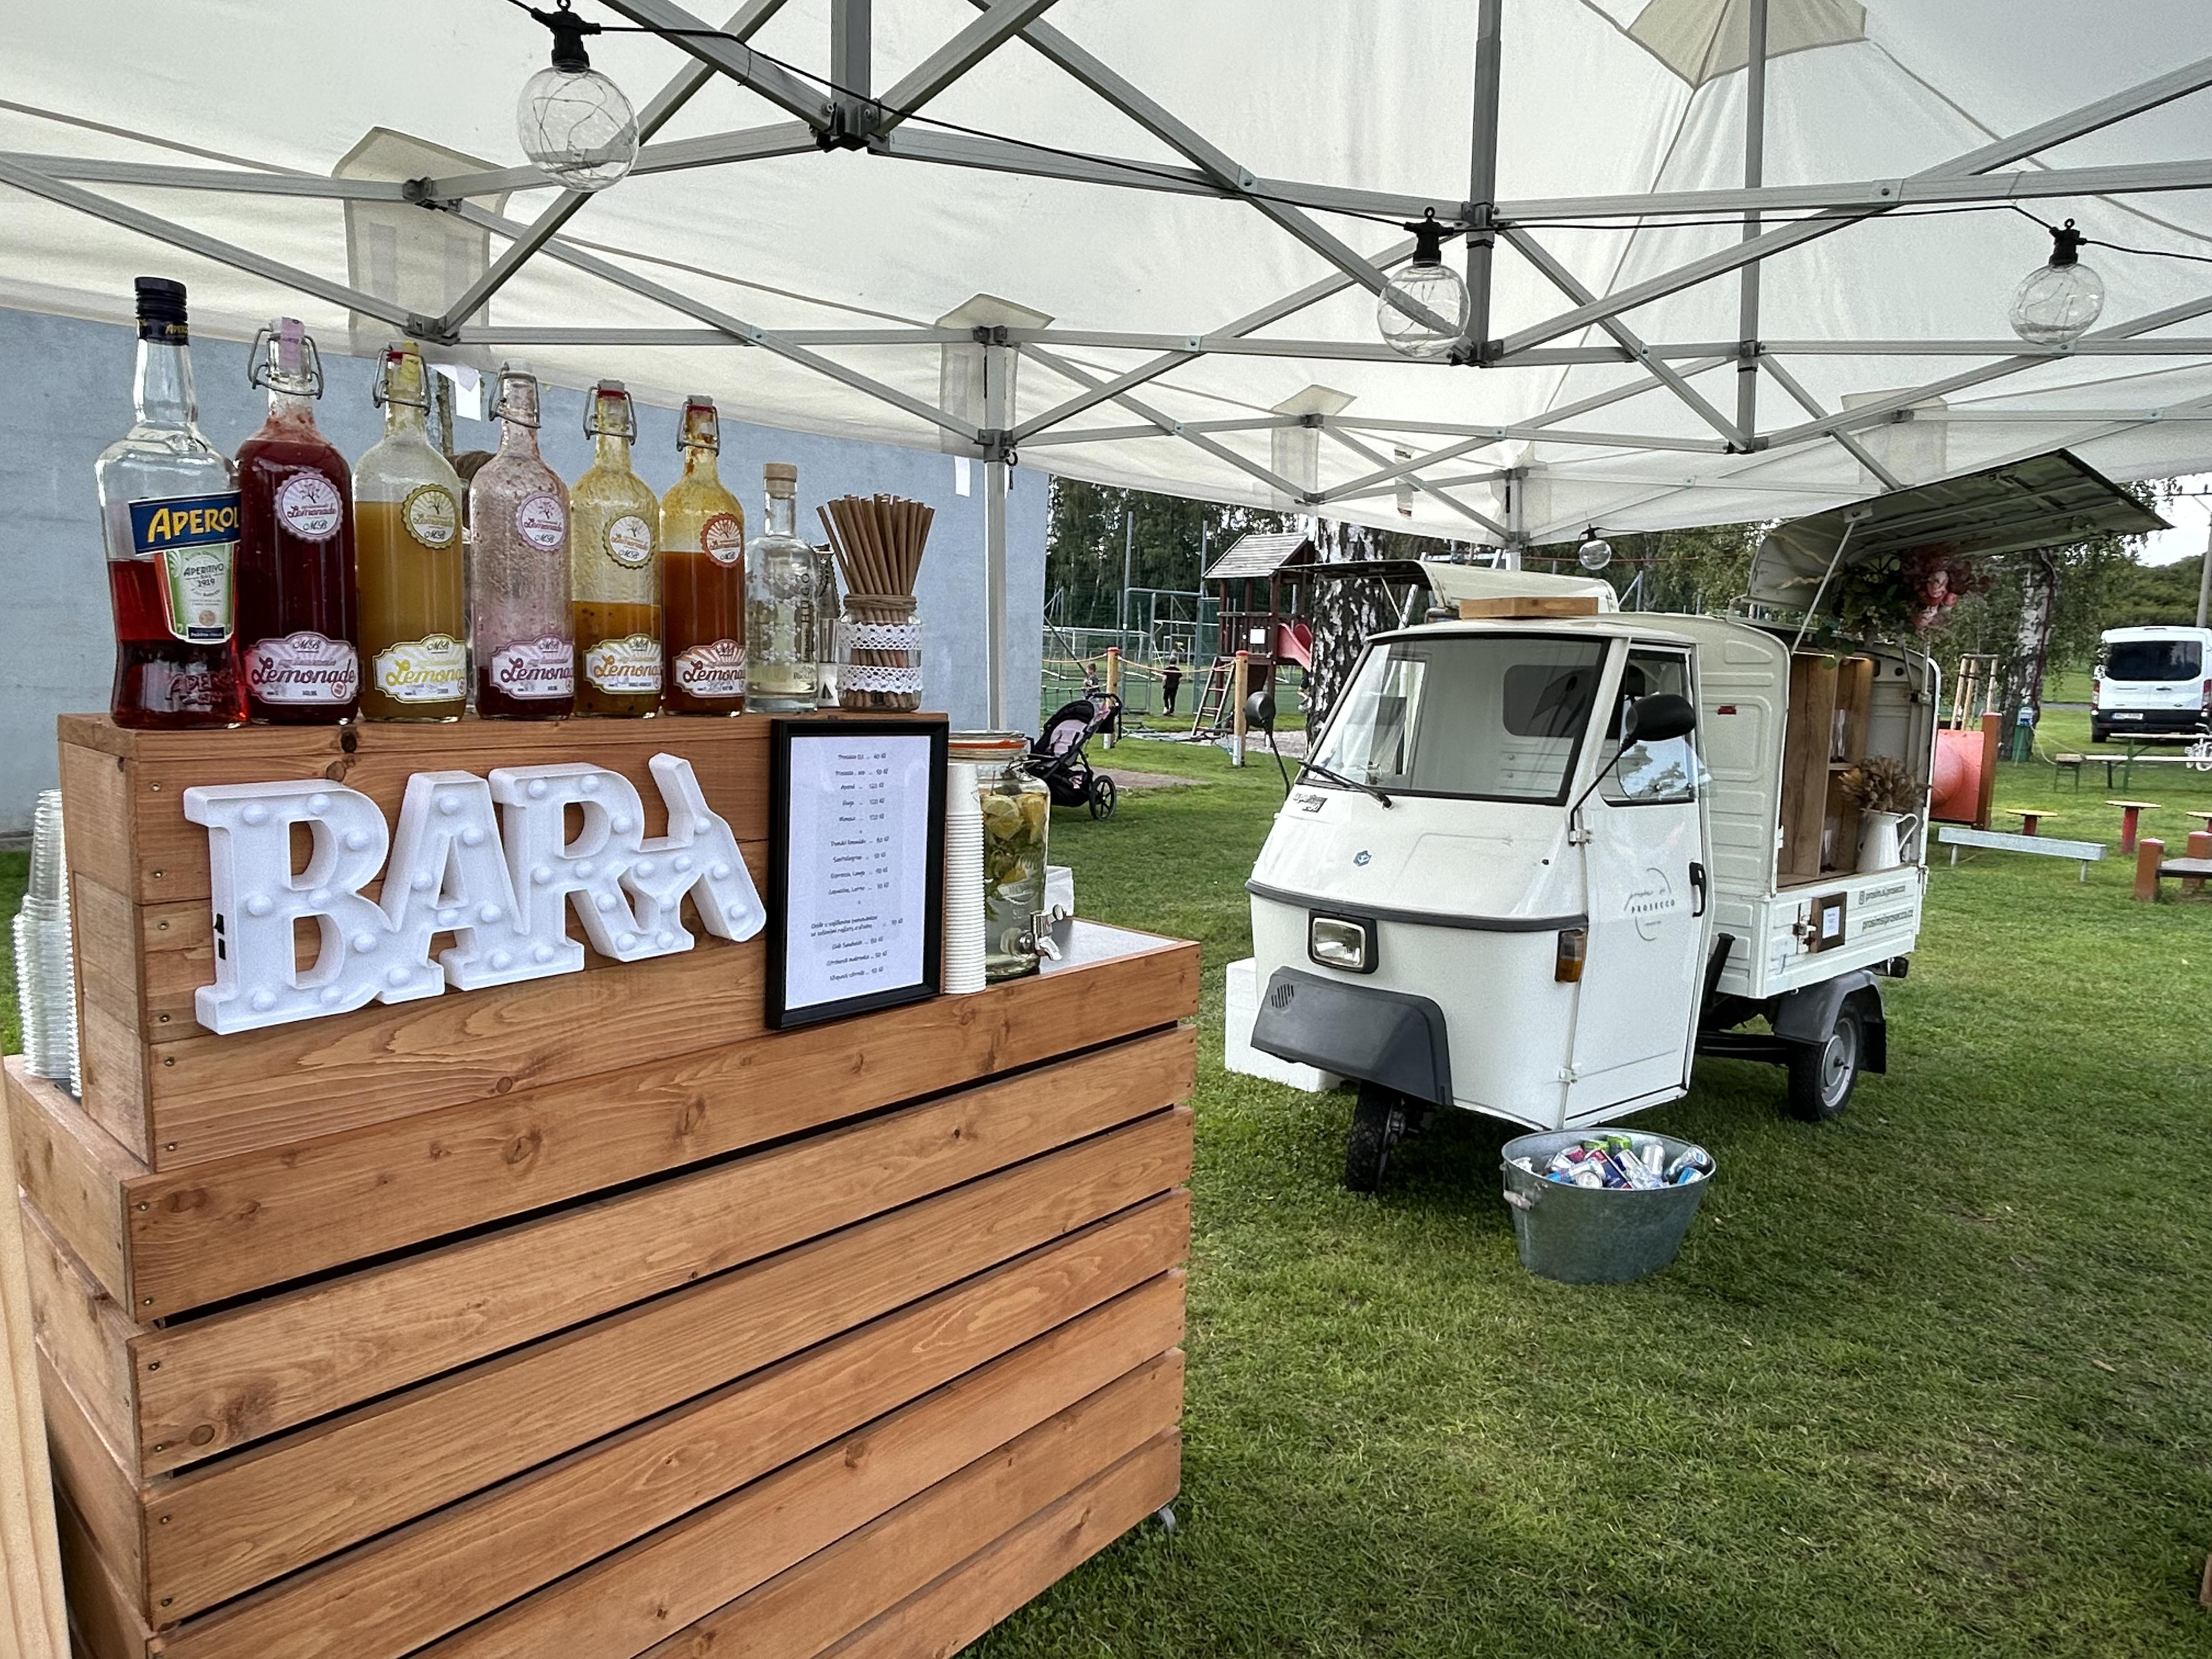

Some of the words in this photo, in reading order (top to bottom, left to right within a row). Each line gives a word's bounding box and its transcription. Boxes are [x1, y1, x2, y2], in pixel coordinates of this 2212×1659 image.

[147, 507, 239, 543] APEROL
[197, 578, 215, 587] 1919
[801, 573, 810, 623] HUGO
[251, 656, 355, 685] Lemonade
[500, 658, 575, 682] Lemona
[593, 654, 662, 678] Lemona
[682, 661, 746, 683] Lemona
[1631, 899, 1675, 914] PROSECCO
